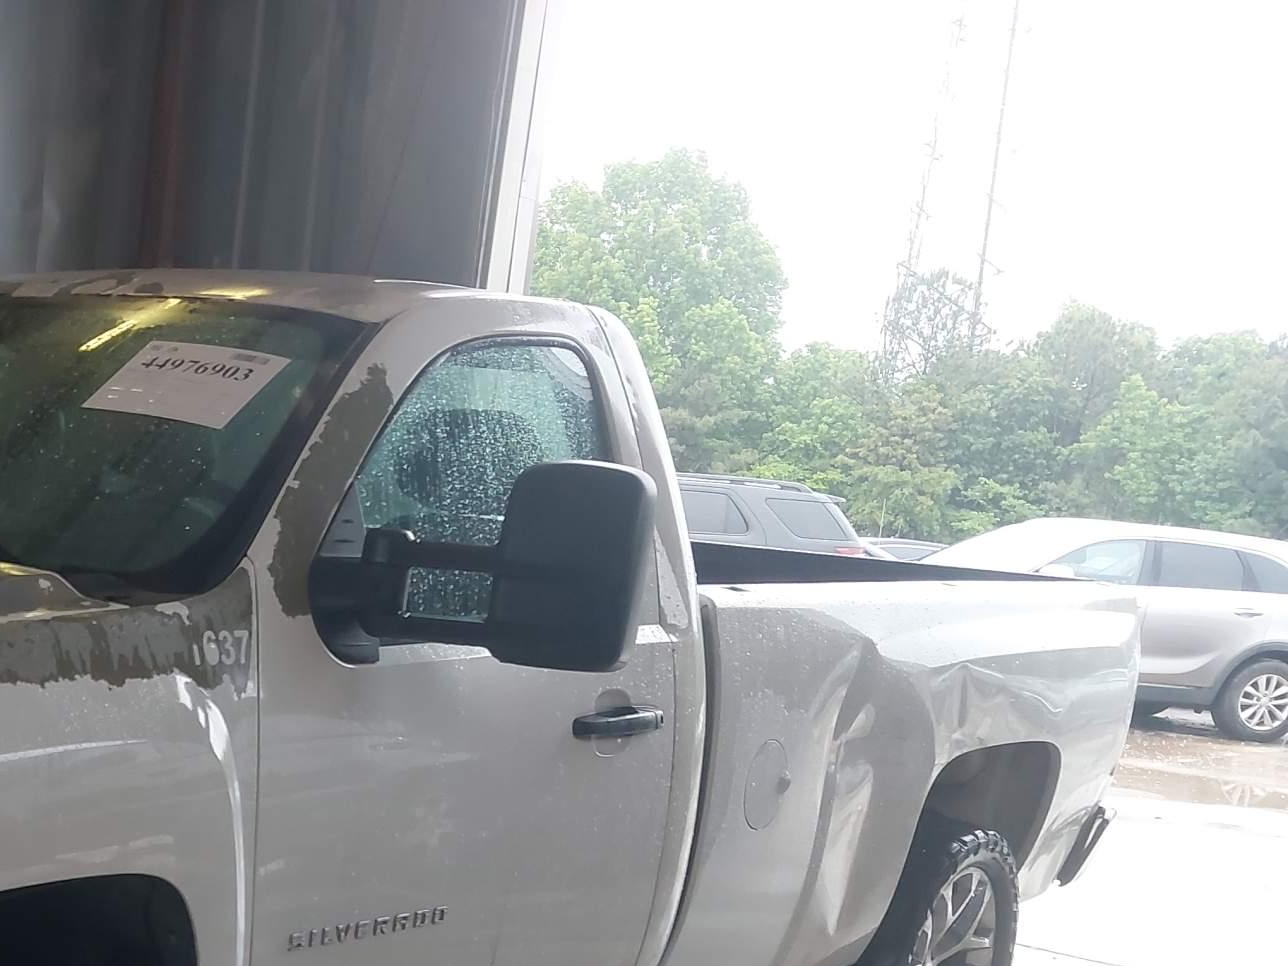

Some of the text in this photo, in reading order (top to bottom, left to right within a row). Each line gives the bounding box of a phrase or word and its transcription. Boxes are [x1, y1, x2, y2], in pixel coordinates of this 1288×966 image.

[141, 355, 254, 382] 44976903
[192, 629, 250, 666] 1637
[287, 904, 449, 952] SILVERADO
